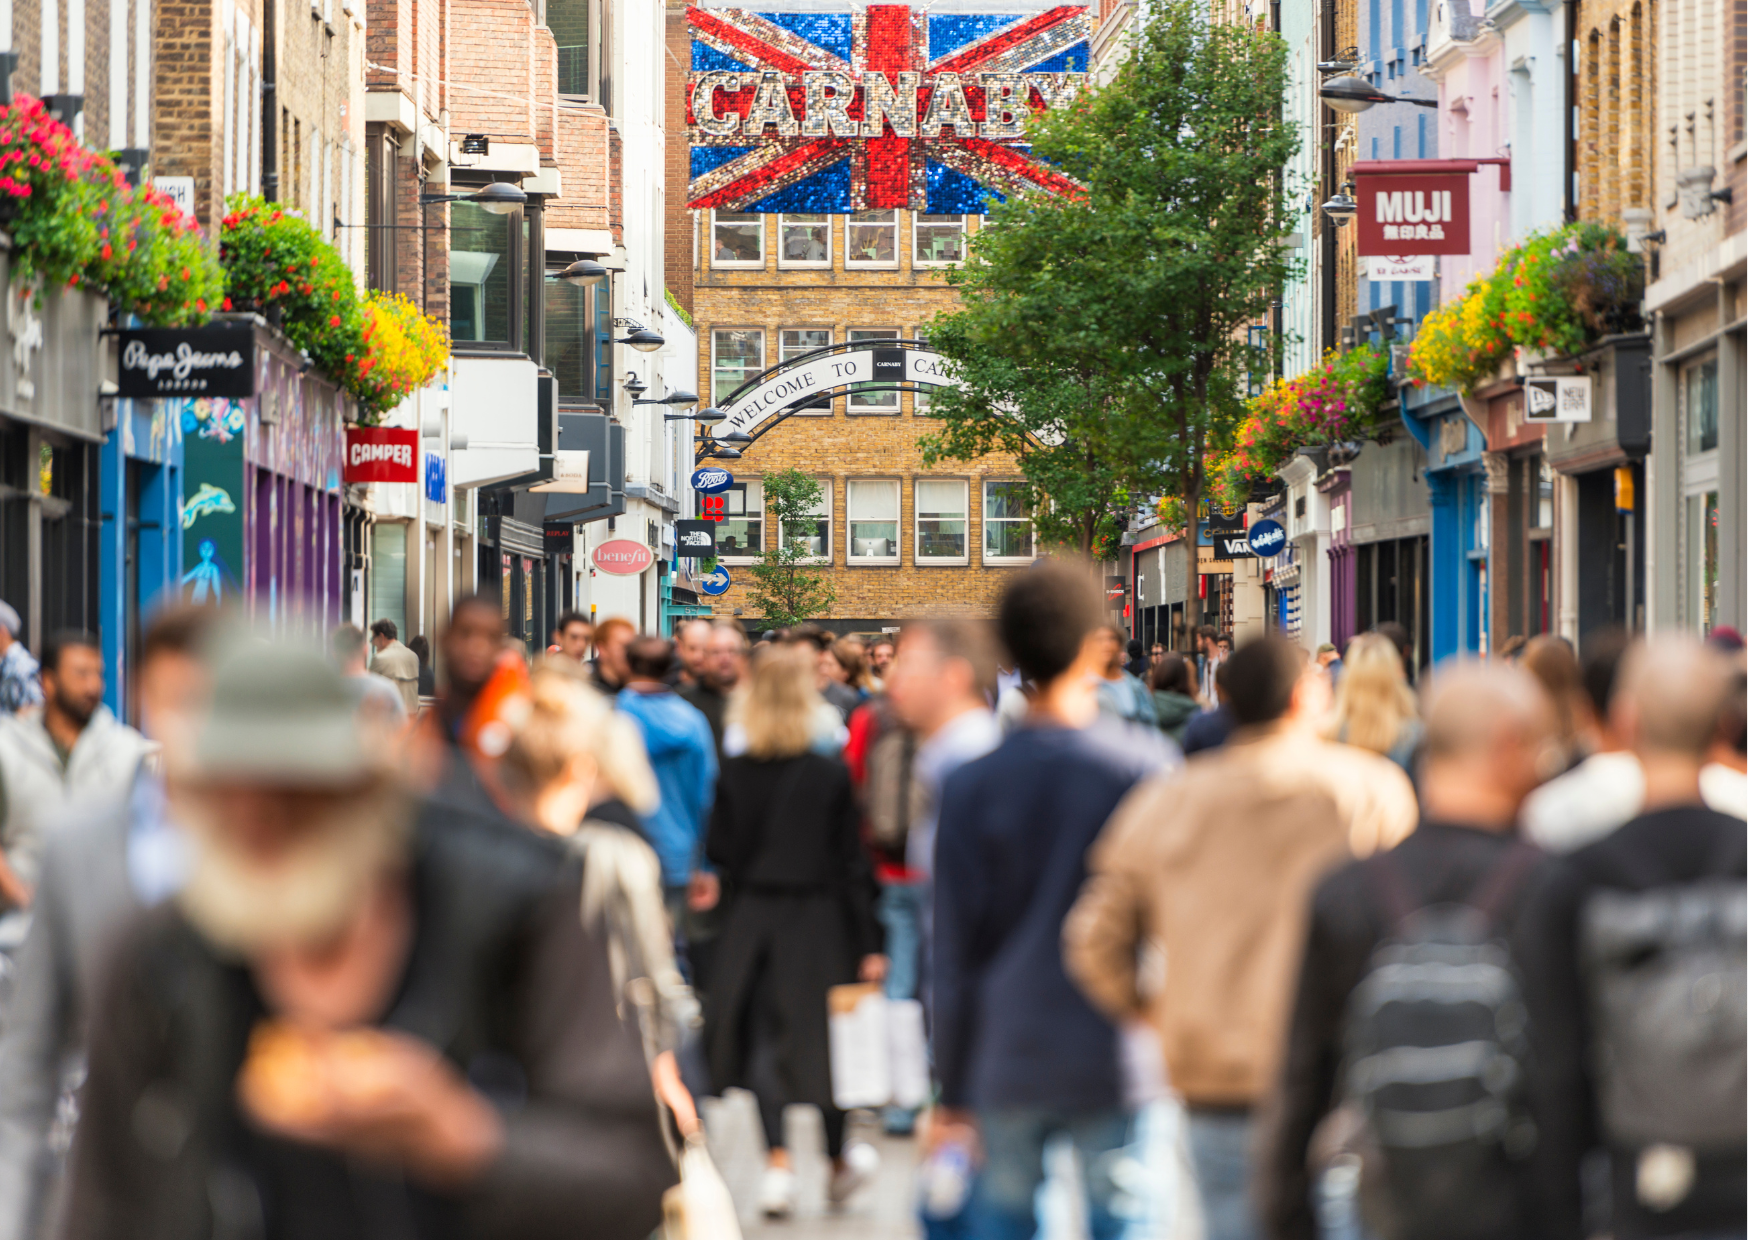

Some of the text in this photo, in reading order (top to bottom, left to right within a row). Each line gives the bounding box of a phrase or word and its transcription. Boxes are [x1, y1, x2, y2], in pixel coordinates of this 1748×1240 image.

[691, 69, 1086, 137] CARNABY
[1376, 191, 1452, 223] MUJI
[1383, 224, 1445, 240] 無印良品
[123, 340, 244, 380] Pepe Jeans
[157, 379, 208, 391] LONDON
[1563, 387, 1584, 398] NEW
[729, 372, 816, 430] WELCOME
[832, 361, 857, 377] TO
[351, 443, 412, 468] CAMPER
[695, 472, 727, 488] Boots
[1224, 539, 1252, 554] VAN
[597, 549, 647, 565] benefit
